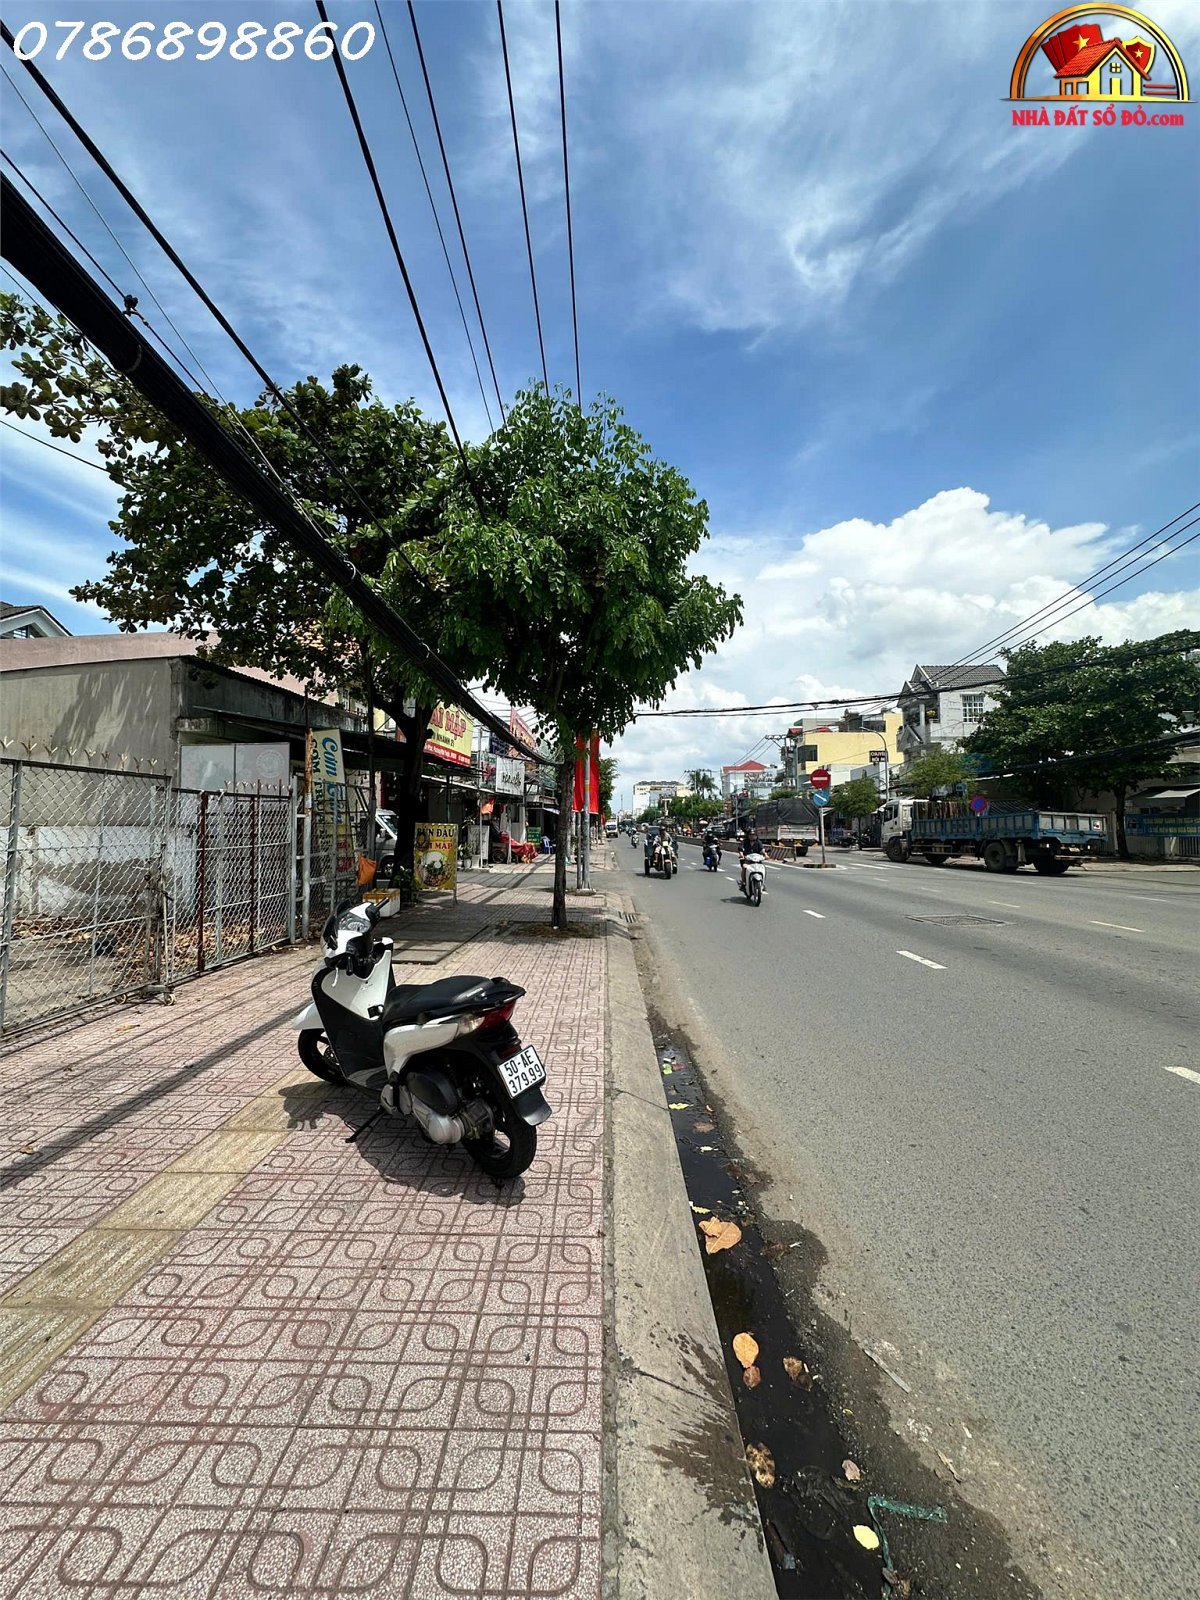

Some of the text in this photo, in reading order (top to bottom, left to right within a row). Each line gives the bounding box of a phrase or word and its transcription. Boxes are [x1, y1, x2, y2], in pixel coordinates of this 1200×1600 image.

[321, 736, 338, 777] Cơm
[504, 1050, 534, 1077] 50-AE
[508, 1063, 543, 1094] 379.99
